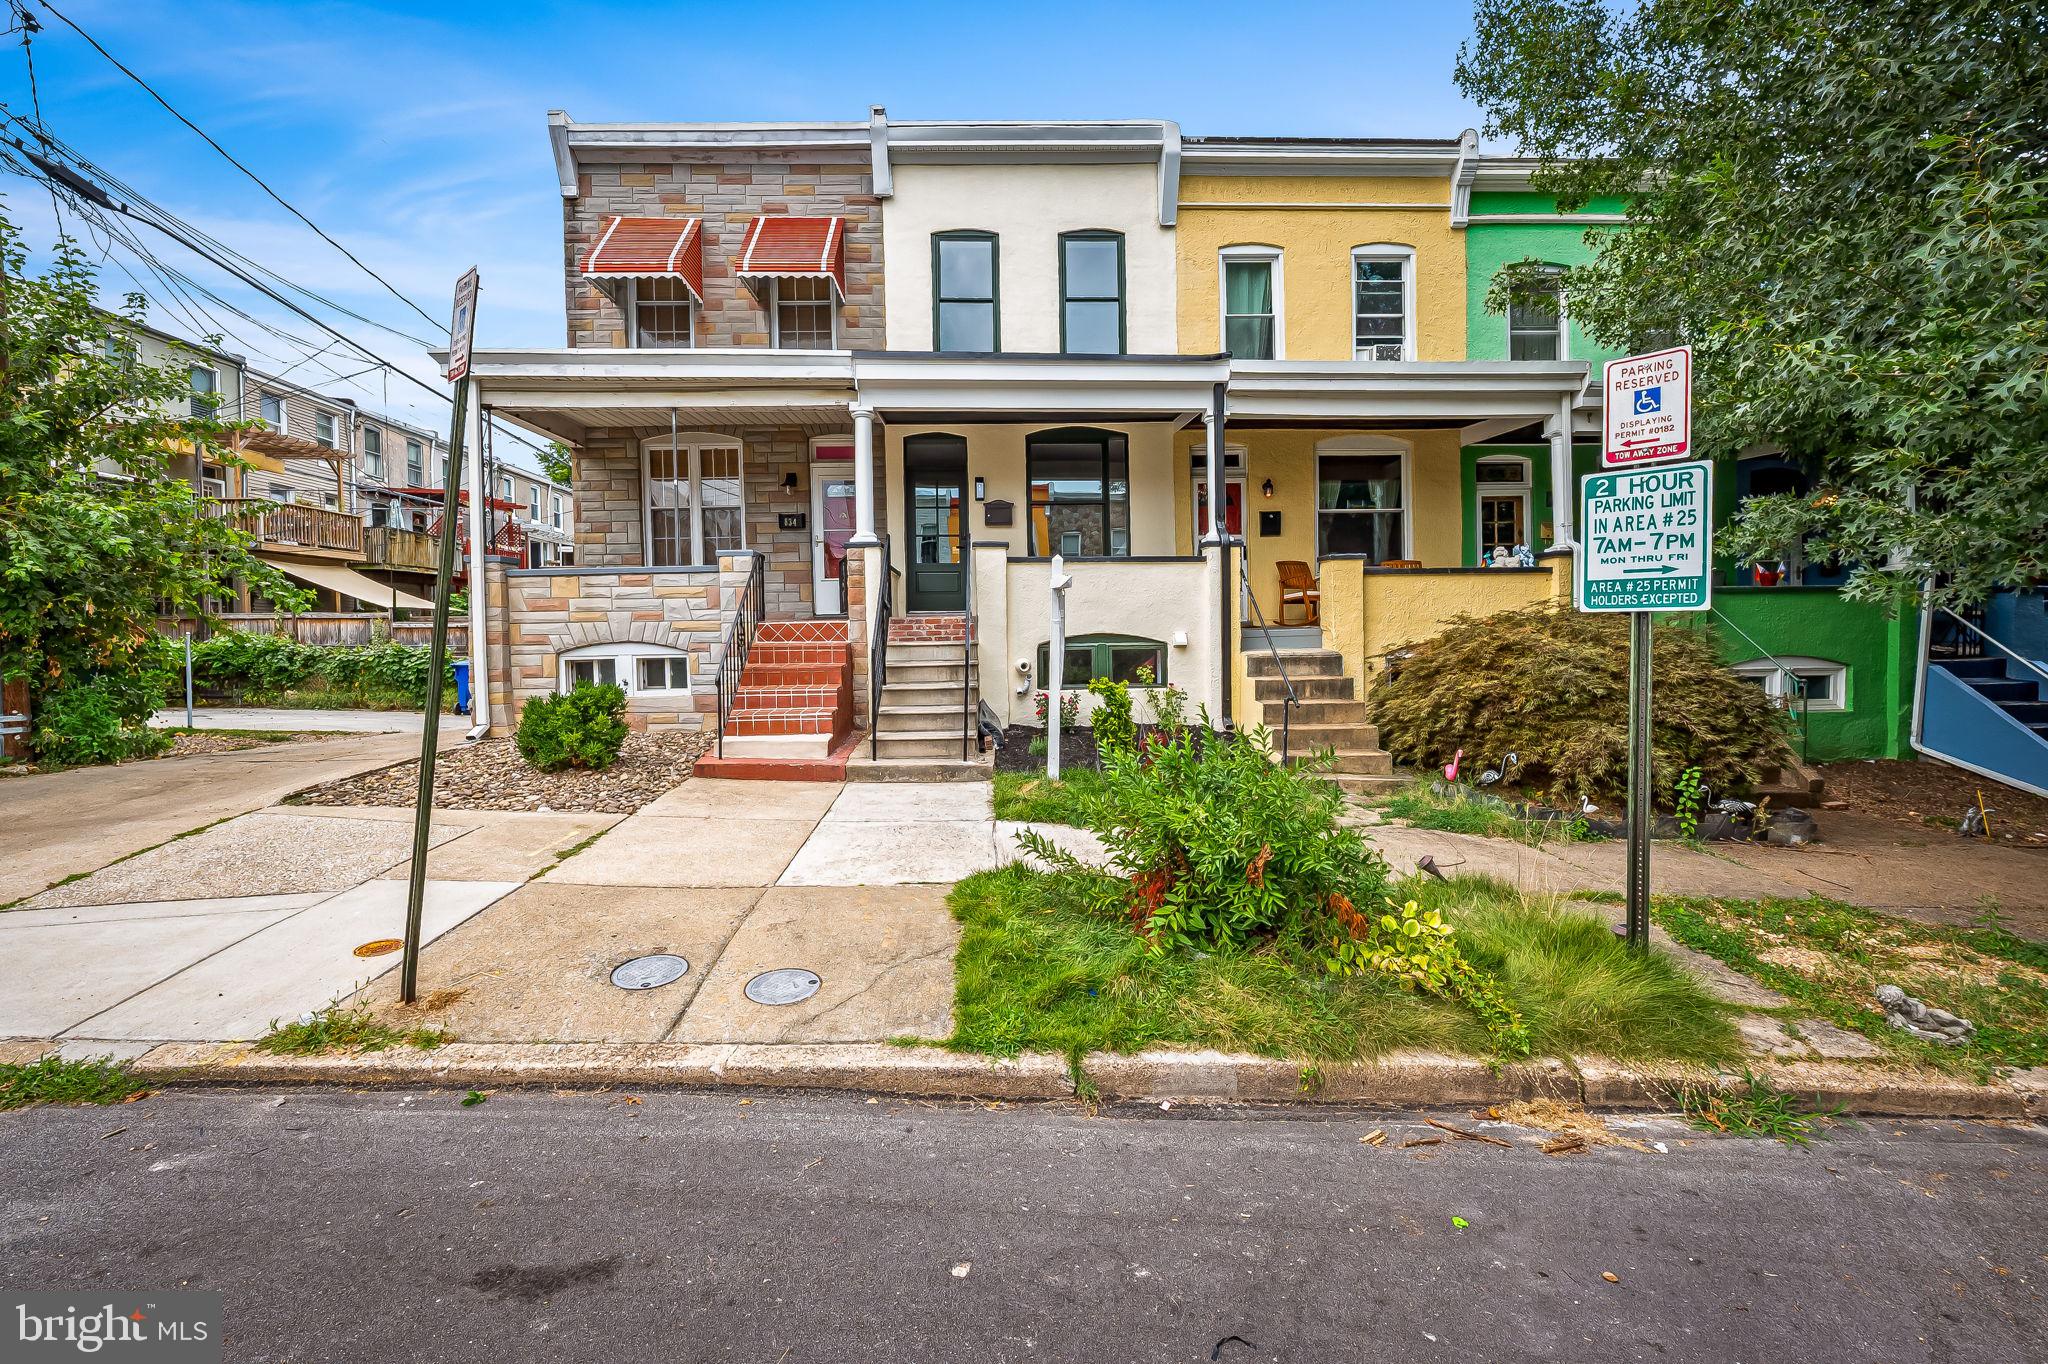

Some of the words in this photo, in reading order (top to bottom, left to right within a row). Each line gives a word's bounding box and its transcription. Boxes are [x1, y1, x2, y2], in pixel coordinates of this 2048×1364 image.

[1621, 359, 1673, 378] PARKING
[1615, 371, 1679, 391] RESERVED
[1620, 415, 1673, 429] DISPLAYING
[1615, 429, 1645, 439] PERMIT
[1649, 425, 1675, 434] #0182
[1615, 451, 1631, 460] TOW
[1632, 448, 1654, 457] AWAY
[1657, 445, 1678, 454] ZONE
[1595, 479, 1609, 496] 2
[1629, 471, 1694, 494] HOUR
[1594, 495, 1654, 514] PARKING
[1661, 491, 1696, 508] LIMIT
[1594, 518, 1608, 534] IN
[1612, 514, 1657, 533] AREA
[1631, 555, 1663, 563] THRU
[1668, 553, 1688, 561] FRI
[1590, 582, 1621, 593] AREA
[1653, 578, 1698, 591] PERMIT
[1590, 594, 1638, 606] HOLDERS
[1641, 593, 1698, 604] EXCEPTED
